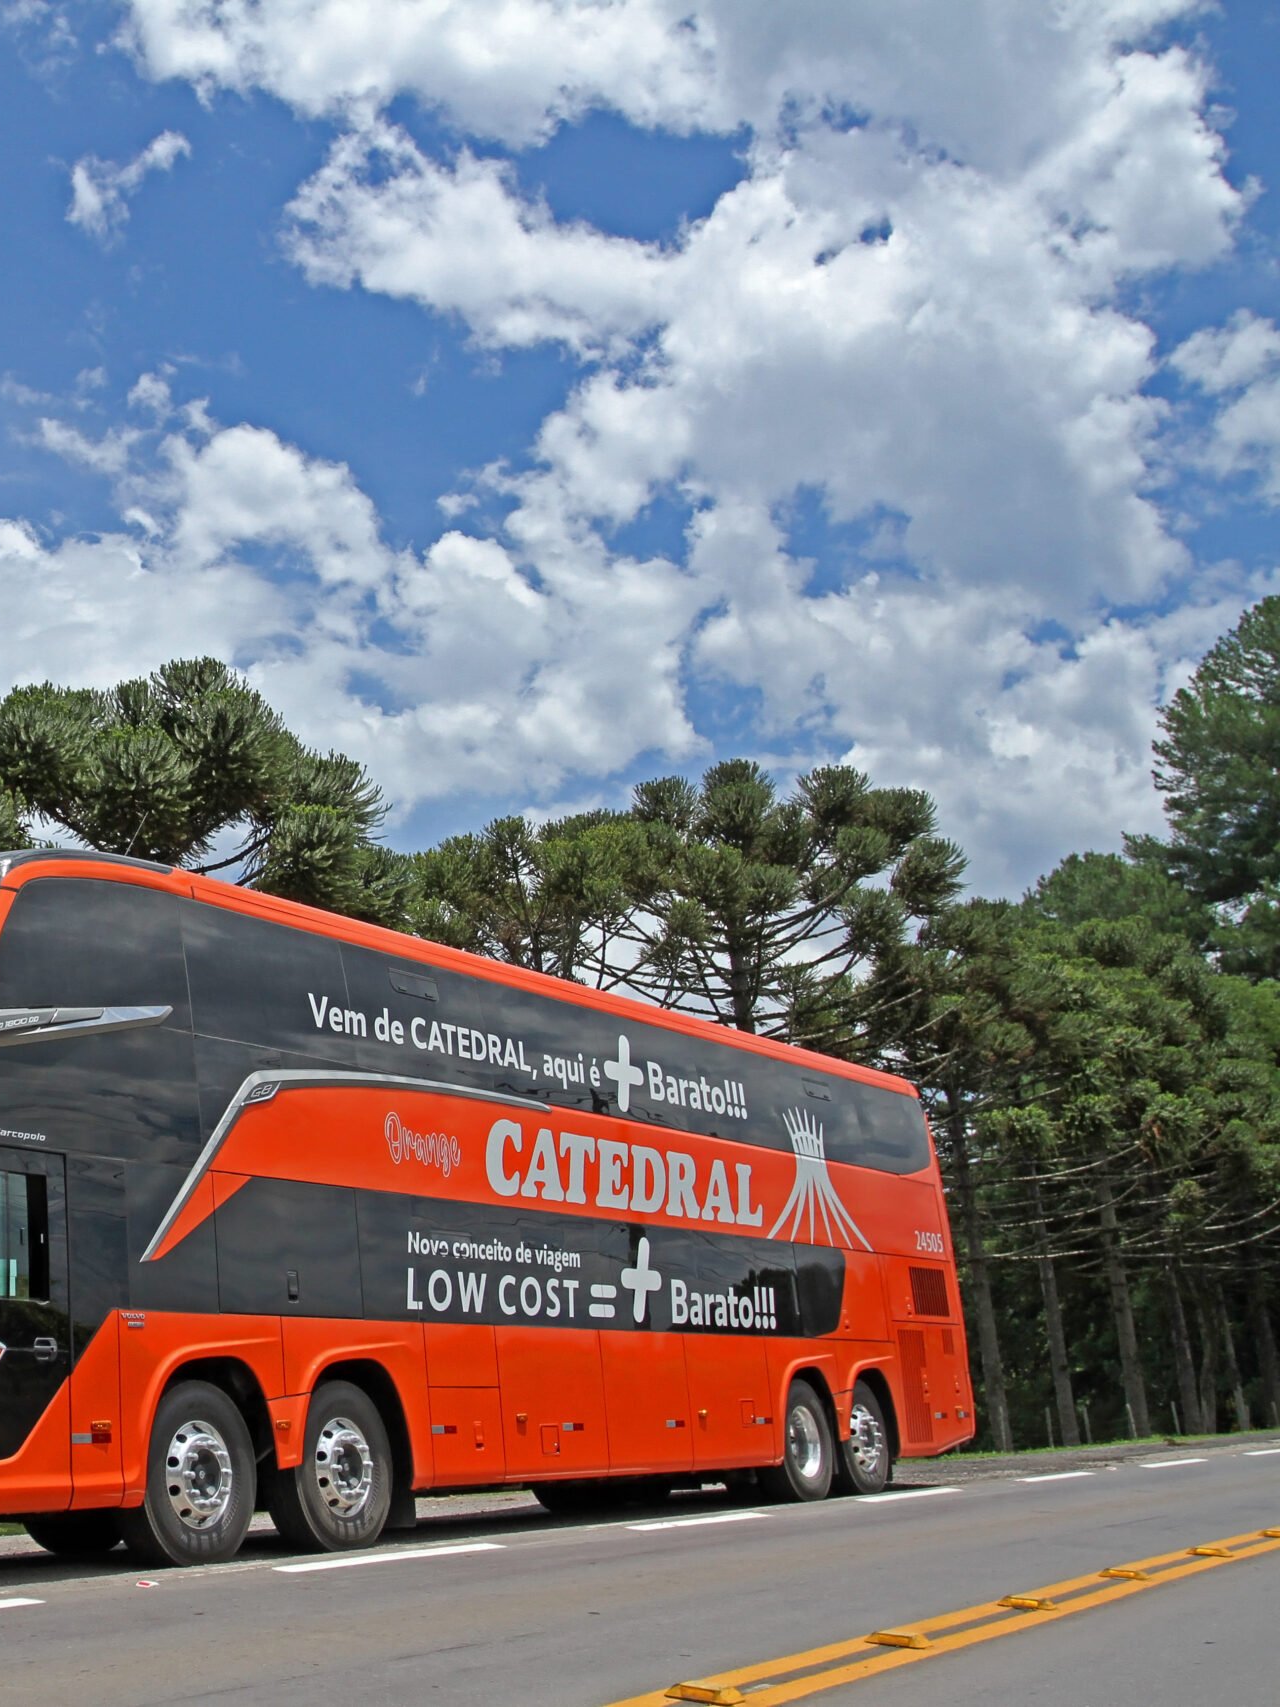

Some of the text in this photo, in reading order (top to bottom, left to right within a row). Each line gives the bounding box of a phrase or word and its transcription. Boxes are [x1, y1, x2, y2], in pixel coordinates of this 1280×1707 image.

[307, 992, 367, 1038] Vem
[374, 1008, 405, 1045] de
[410, 1017, 538, 1081] CATEDRAL,
[543, 1053, 586, 1090] aqui
[589, 1057, 601, 1088] é
[646, 1060, 748, 1120] Barato!!!
[384, 1111, 461, 1178] Orange
[485, 1118, 763, 1227] CATEDRAL
[407, 1231, 581, 1273] Novo conceito de viagem
[914, 1230, 944, 1253] 24505
[406, 1267, 487, 1313] LOW
[498, 1274, 580, 1319] COST
[670, 1278, 777, 1330] Barato!!!
